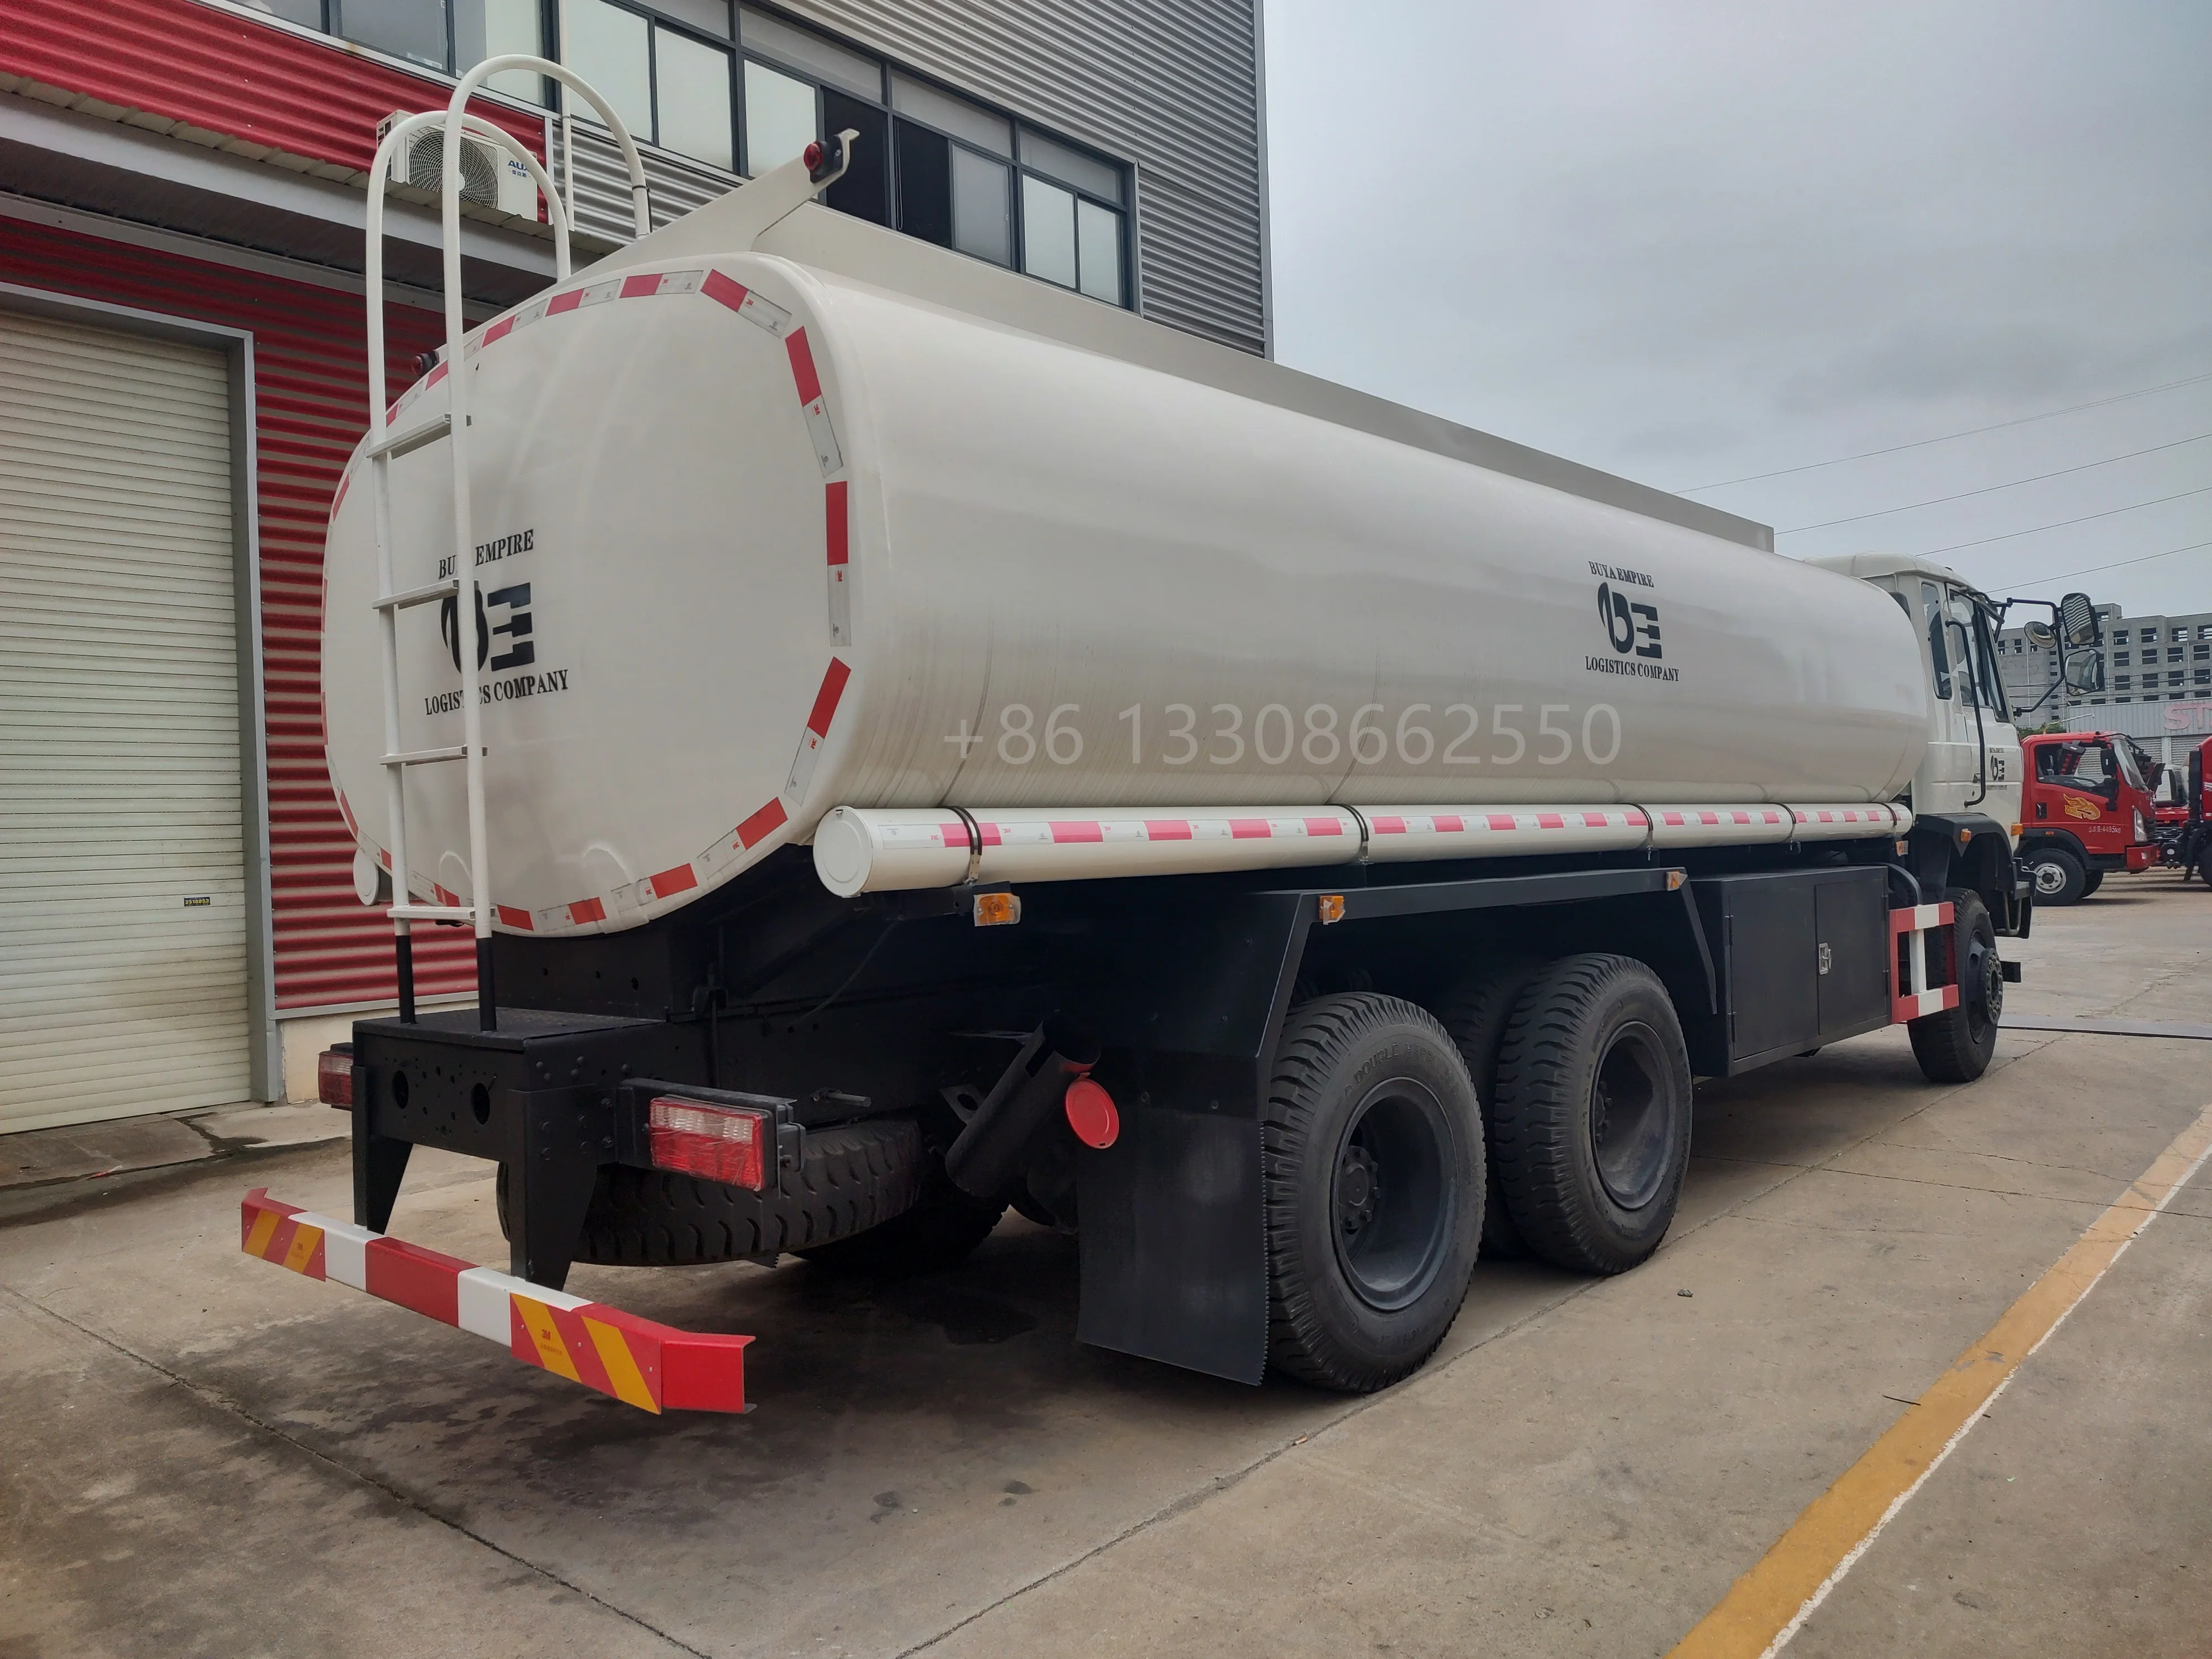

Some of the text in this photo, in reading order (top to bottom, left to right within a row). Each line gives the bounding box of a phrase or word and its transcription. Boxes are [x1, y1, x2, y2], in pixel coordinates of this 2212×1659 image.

[439, 529, 534, 579] BU EMPIRE
[1588, 561, 1654, 588] BUYA EMPIRE
[1585, 656, 1679, 682] LOGISTICS COMPANY
[425, 670, 568, 715] LOGISS COMPANY
[2163, 703, 2212, 731] ST
[1354, 1042, 1400, 1084] DOUBLE
